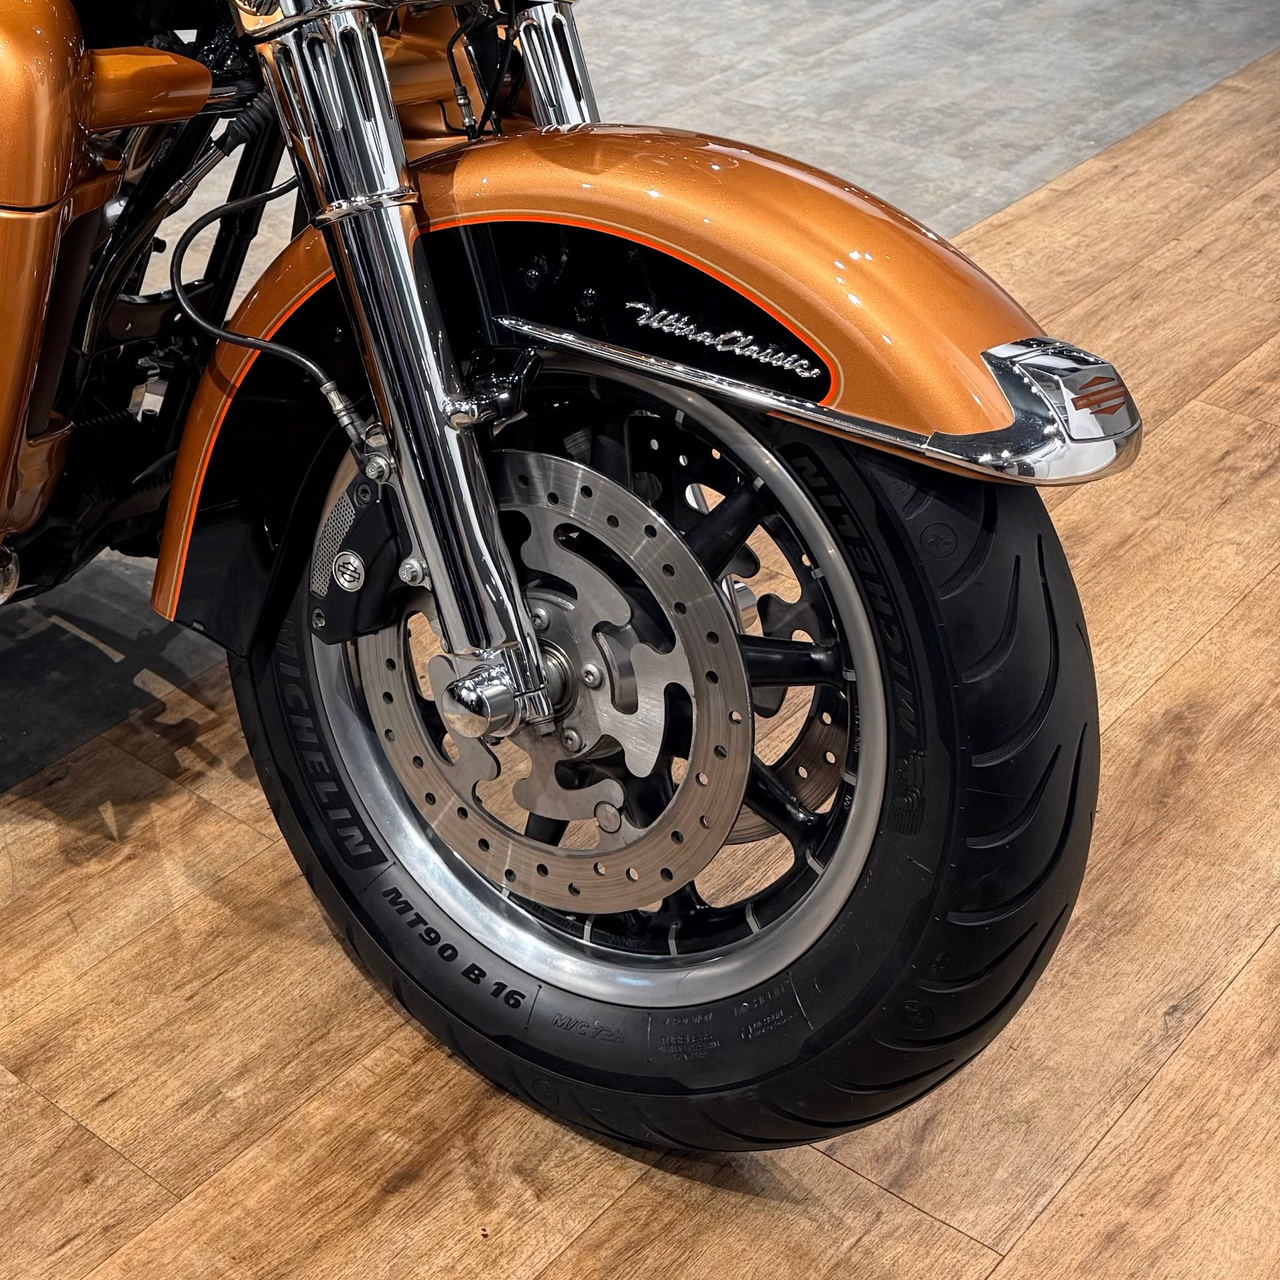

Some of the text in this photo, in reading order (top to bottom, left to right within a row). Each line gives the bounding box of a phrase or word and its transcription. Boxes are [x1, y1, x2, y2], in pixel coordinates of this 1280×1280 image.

[791, 456, 918, 738] MICHELIN
[277, 618, 373, 856] MICHELIN
[381, 886, 526, 1009] MT90 B 16
[552, 1011, 628, 1044] M/C 72H
